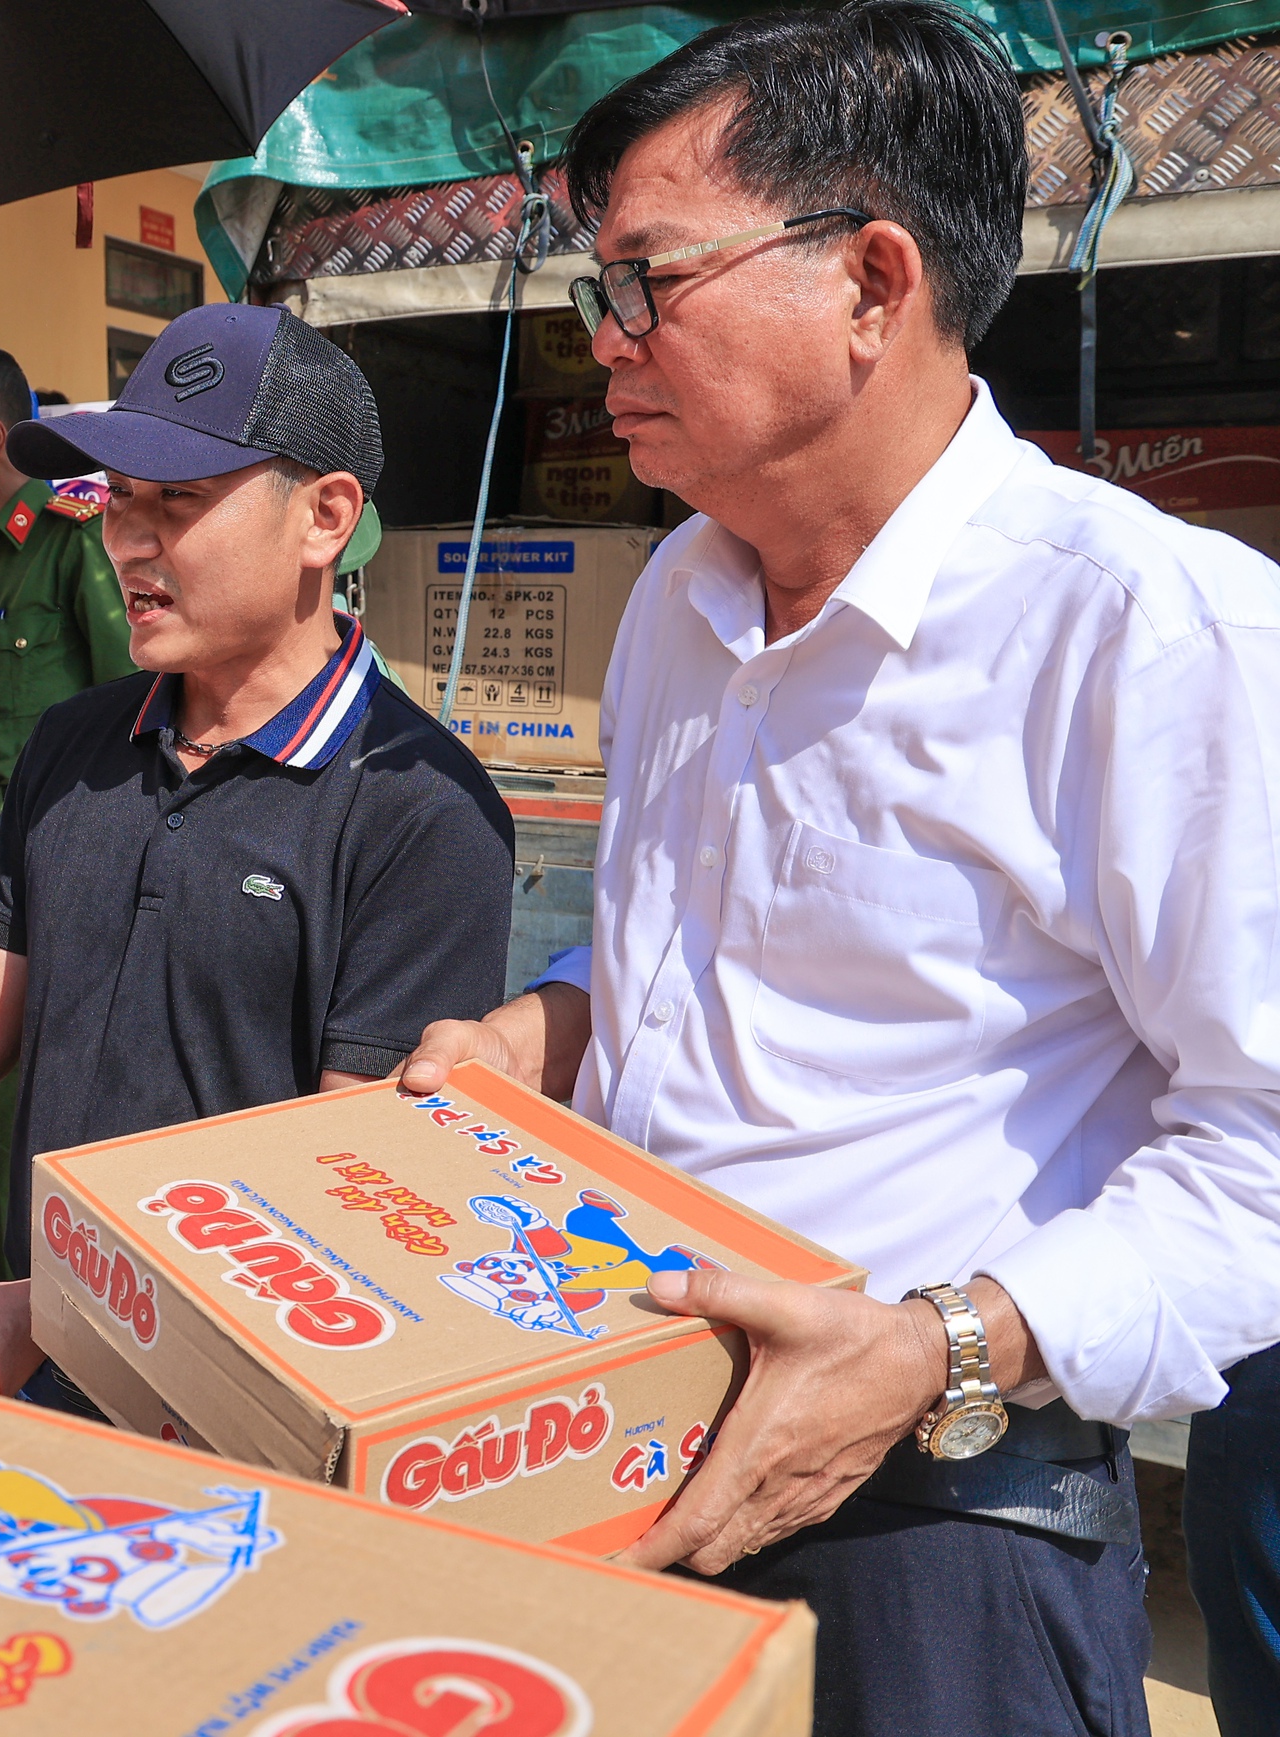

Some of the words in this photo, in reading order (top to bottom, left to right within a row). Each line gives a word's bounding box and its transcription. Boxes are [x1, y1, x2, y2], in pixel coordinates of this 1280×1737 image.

[491, 552, 540, 563] POWER
[544, 552, 569, 562] KIT
[504, 591, 555, 602] SPK-02
[490, 609, 505, 620] 12
[525, 609, 555, 620] PCS
[484, 628, 512, 639] 22.8
[525, 629, 554, 640] KGS
[482, 648, 510, 659] 24.3
[524, 648, 553, 659] KGS
[537, 666, 555, 677] CM
[448, 720, 472, 734] DE
[478, 721, 500, 736] IN
[506, 722, 575, 738] CHINA
[264, 1206, 297, 1229] NGON
[371, 1286, 393, 1302] PHI
[612, 1440, 666, 1488] Gà
